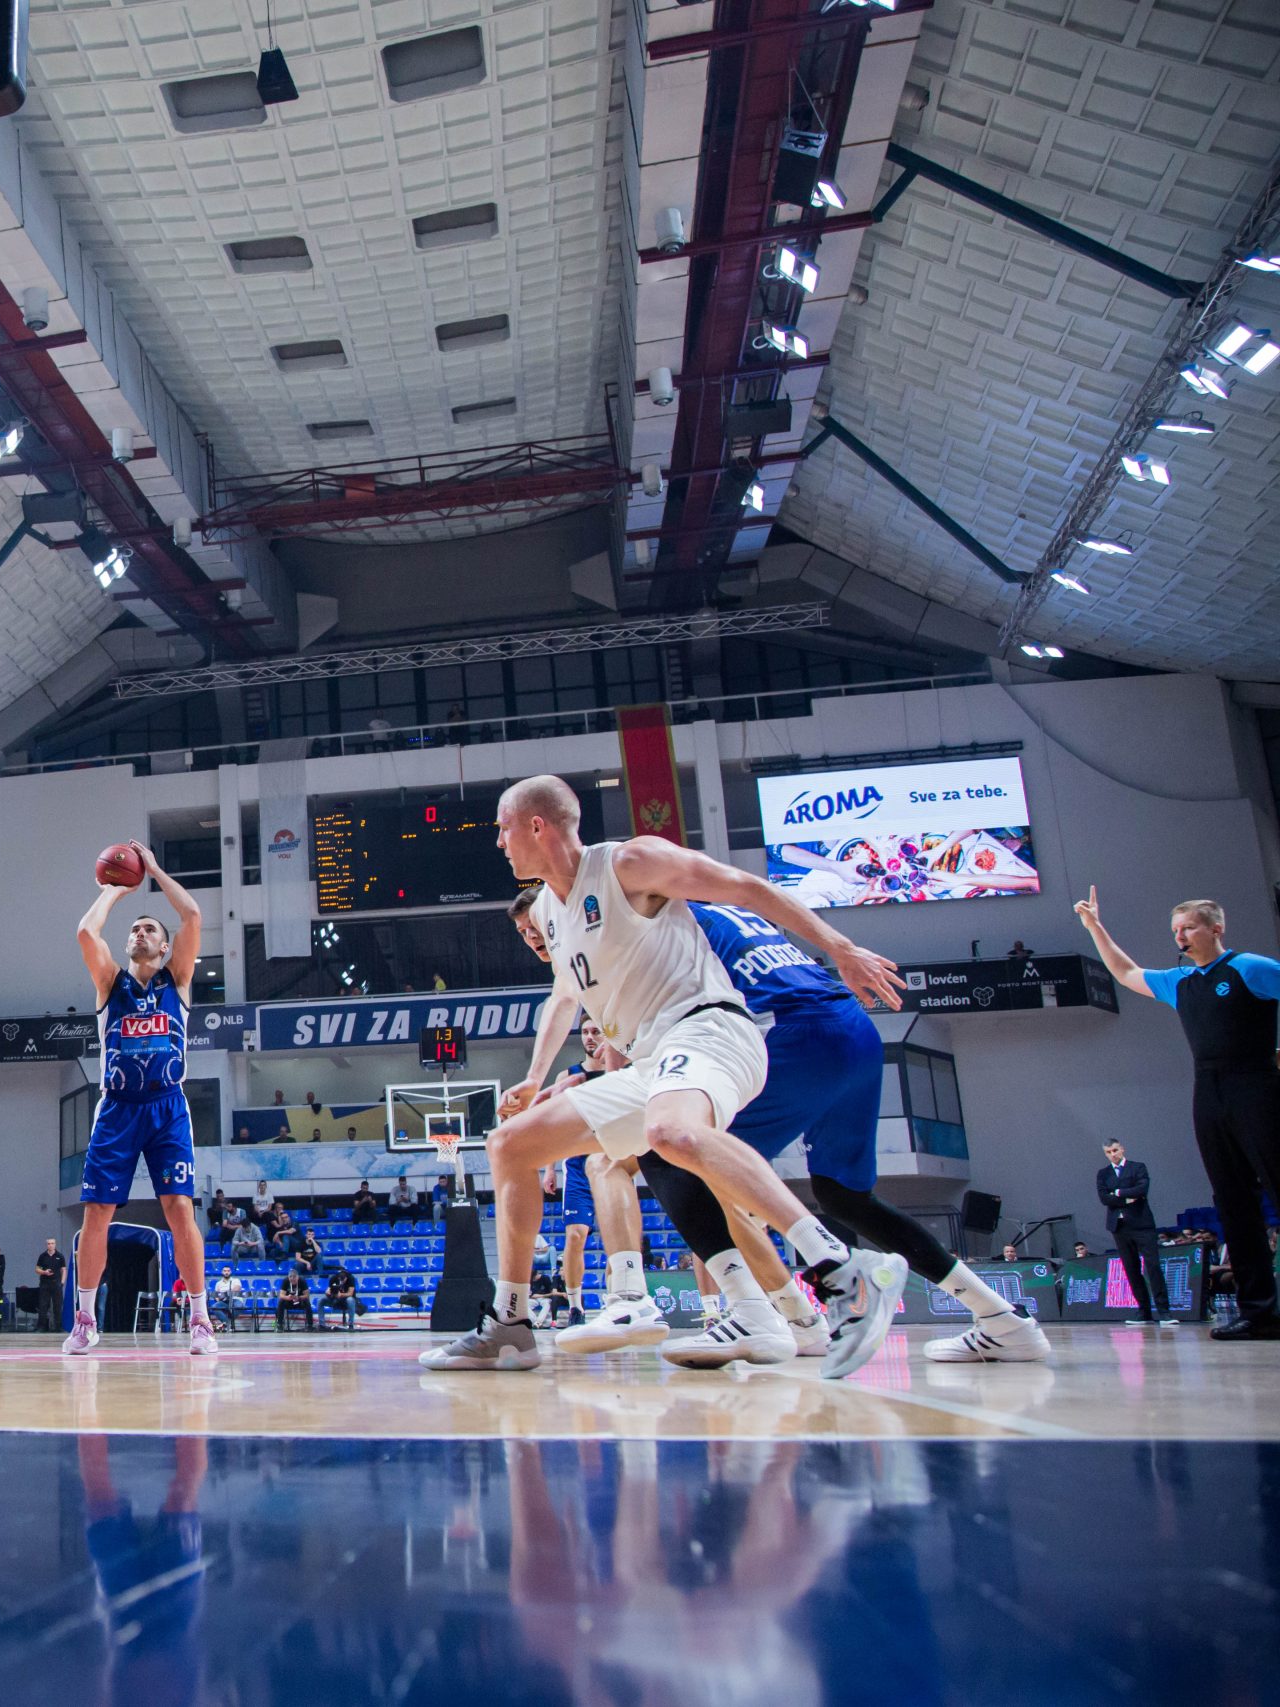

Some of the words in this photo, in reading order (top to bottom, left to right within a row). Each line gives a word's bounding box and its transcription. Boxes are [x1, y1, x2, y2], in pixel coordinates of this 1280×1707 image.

[909, 790, 937, 804] Sve
[942, 787, 961, 801] za
[965, 785, 1008, 800] tebe.
[425, 806, 437, 823] 0
[783, 785, 884, 825] AROMA
[569, 951, 599, 992] 12
[928, 973, 968, 986] lovćen
[136, 993, 157, 1012] 34
[920, 995, 970, 1008] stadion
[125, 1016, 165, 1035] VOLI
[222, 1014, 244, 1026] NLB
[293, 1012, 357, 1046] SVI
[366, 1009, 411, 1042] ZA
[436, 1028, 452, 1041] 1.3
[436, 1042, 456, 1061] 14
[658, 1054, 689, 1077] 12
